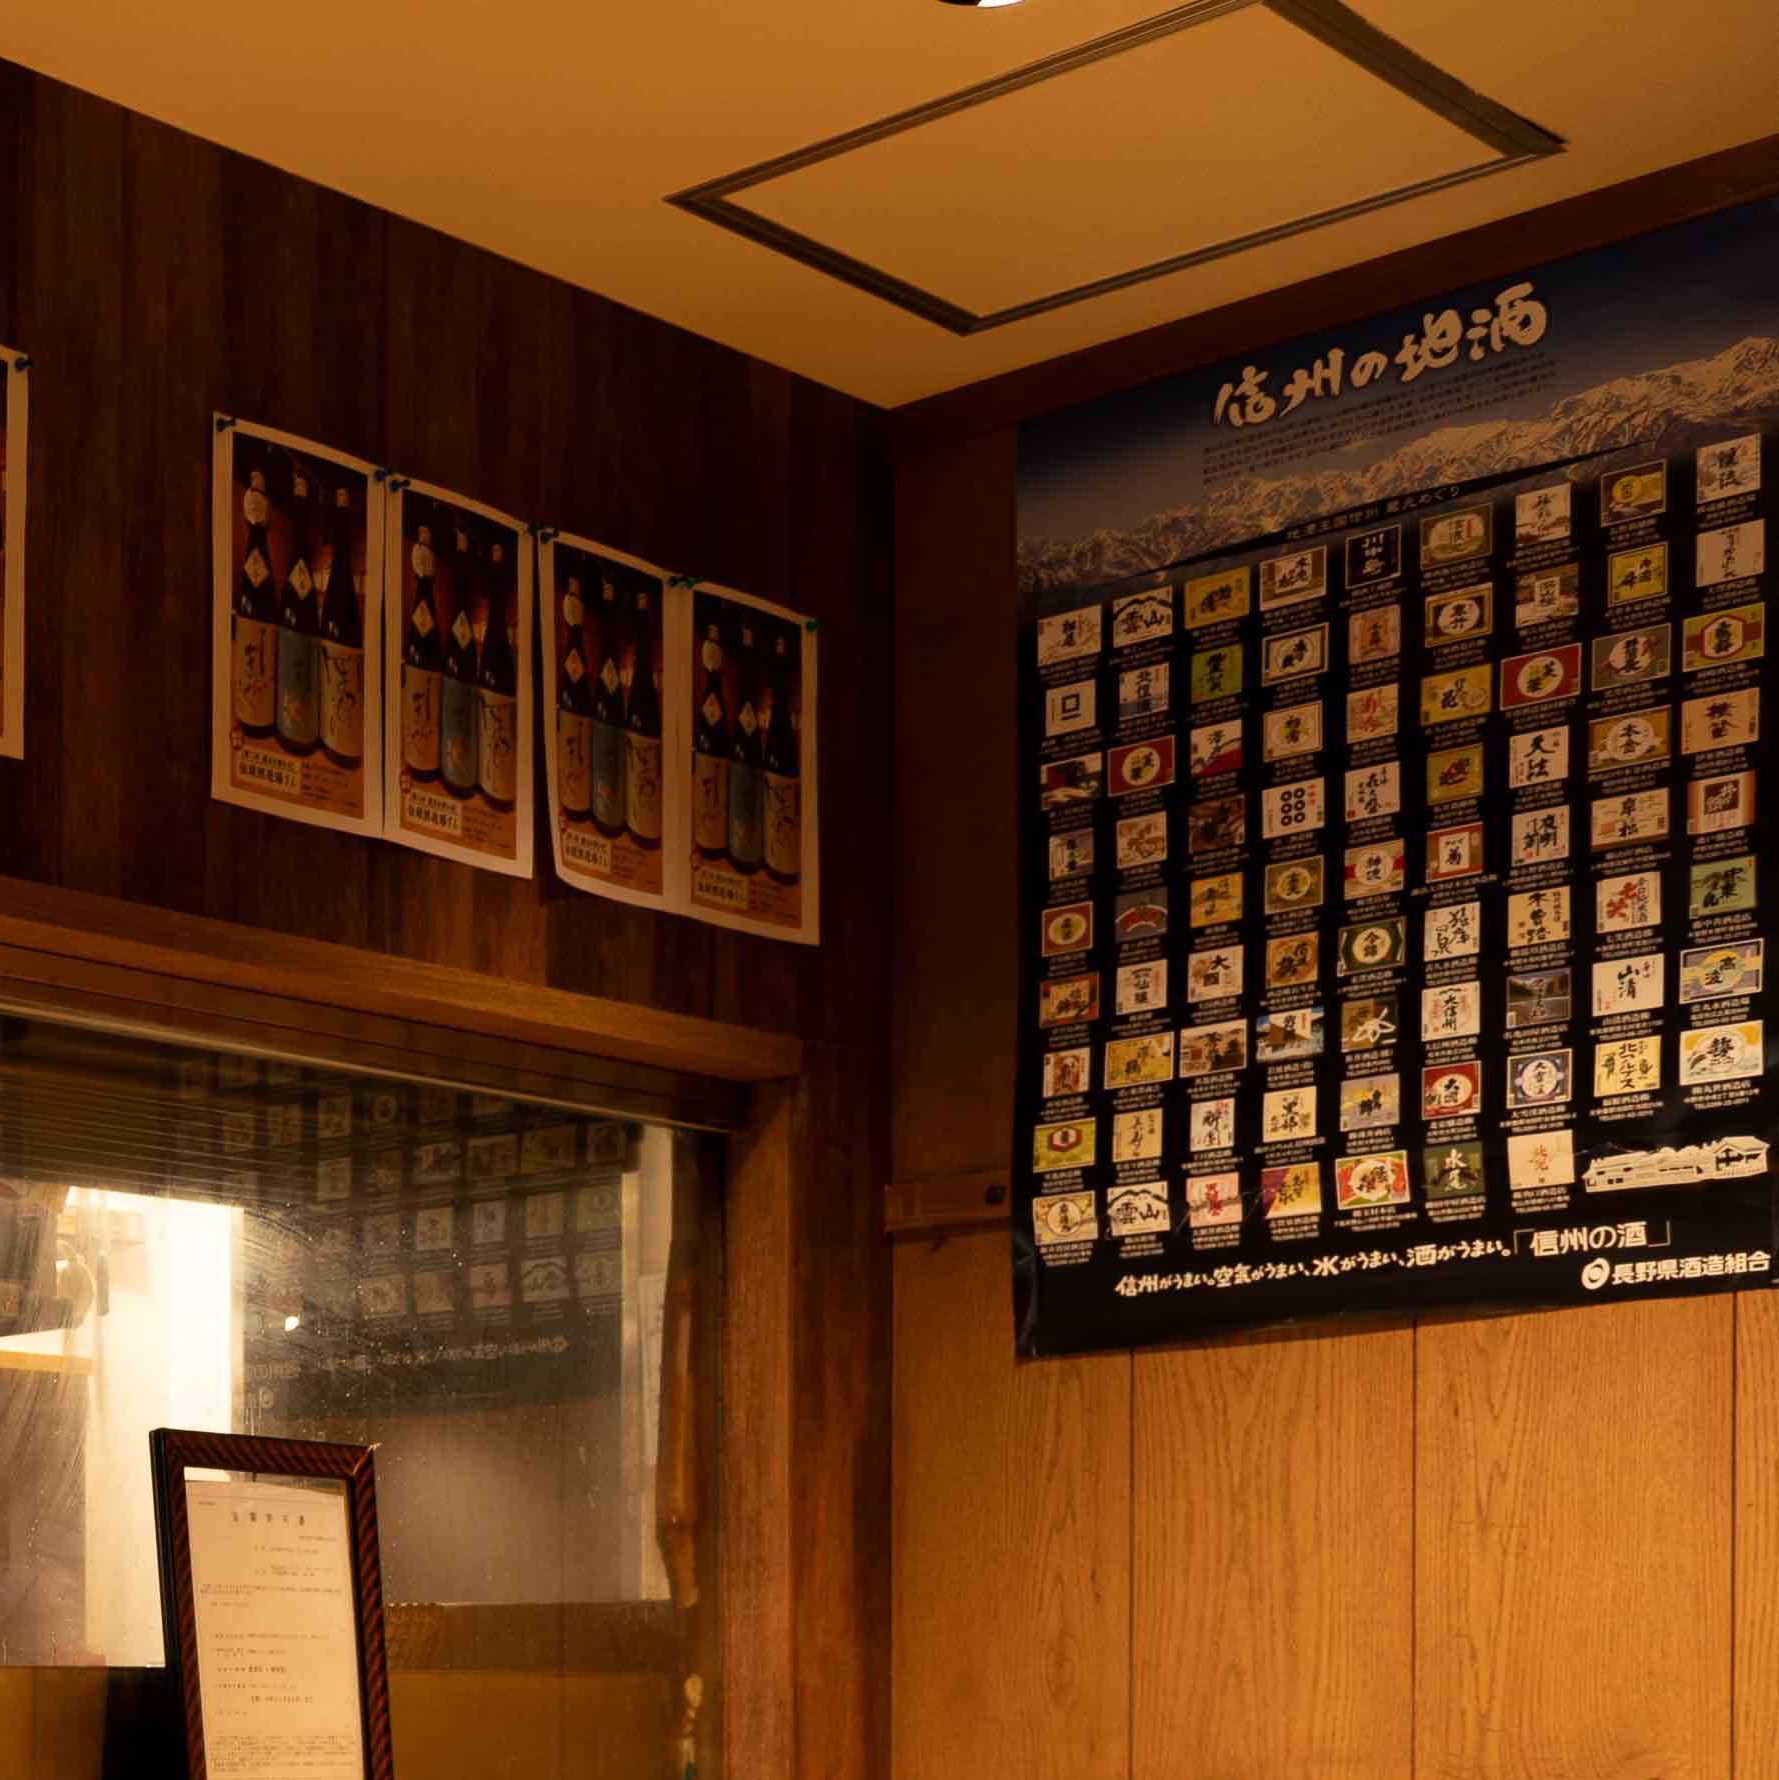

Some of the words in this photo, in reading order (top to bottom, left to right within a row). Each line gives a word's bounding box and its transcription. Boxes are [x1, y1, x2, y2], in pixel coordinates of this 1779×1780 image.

[1214, 280, 1549, 428] 信州の地酒
[1612, 1250, 1774, 1287] 長野県酒造組合
